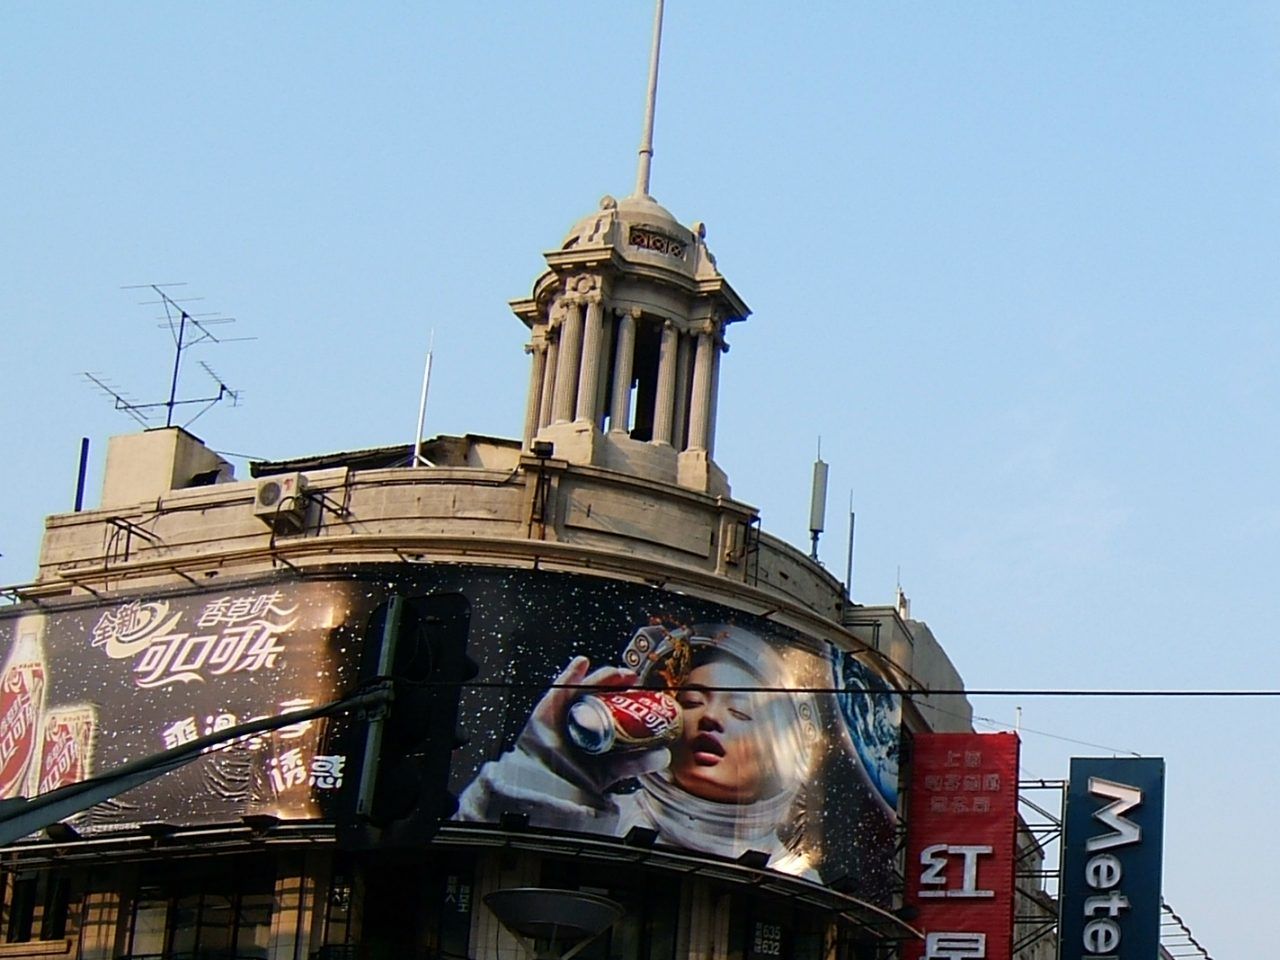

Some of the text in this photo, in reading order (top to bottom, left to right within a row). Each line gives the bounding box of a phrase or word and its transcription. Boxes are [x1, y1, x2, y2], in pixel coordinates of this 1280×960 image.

[91, 599, 141, 647] 全新
[197, 591, 299, 627] 香草味
[133, 619, 300, 688] 可口可乐
[270, 748, 347, 792] 诱惑
